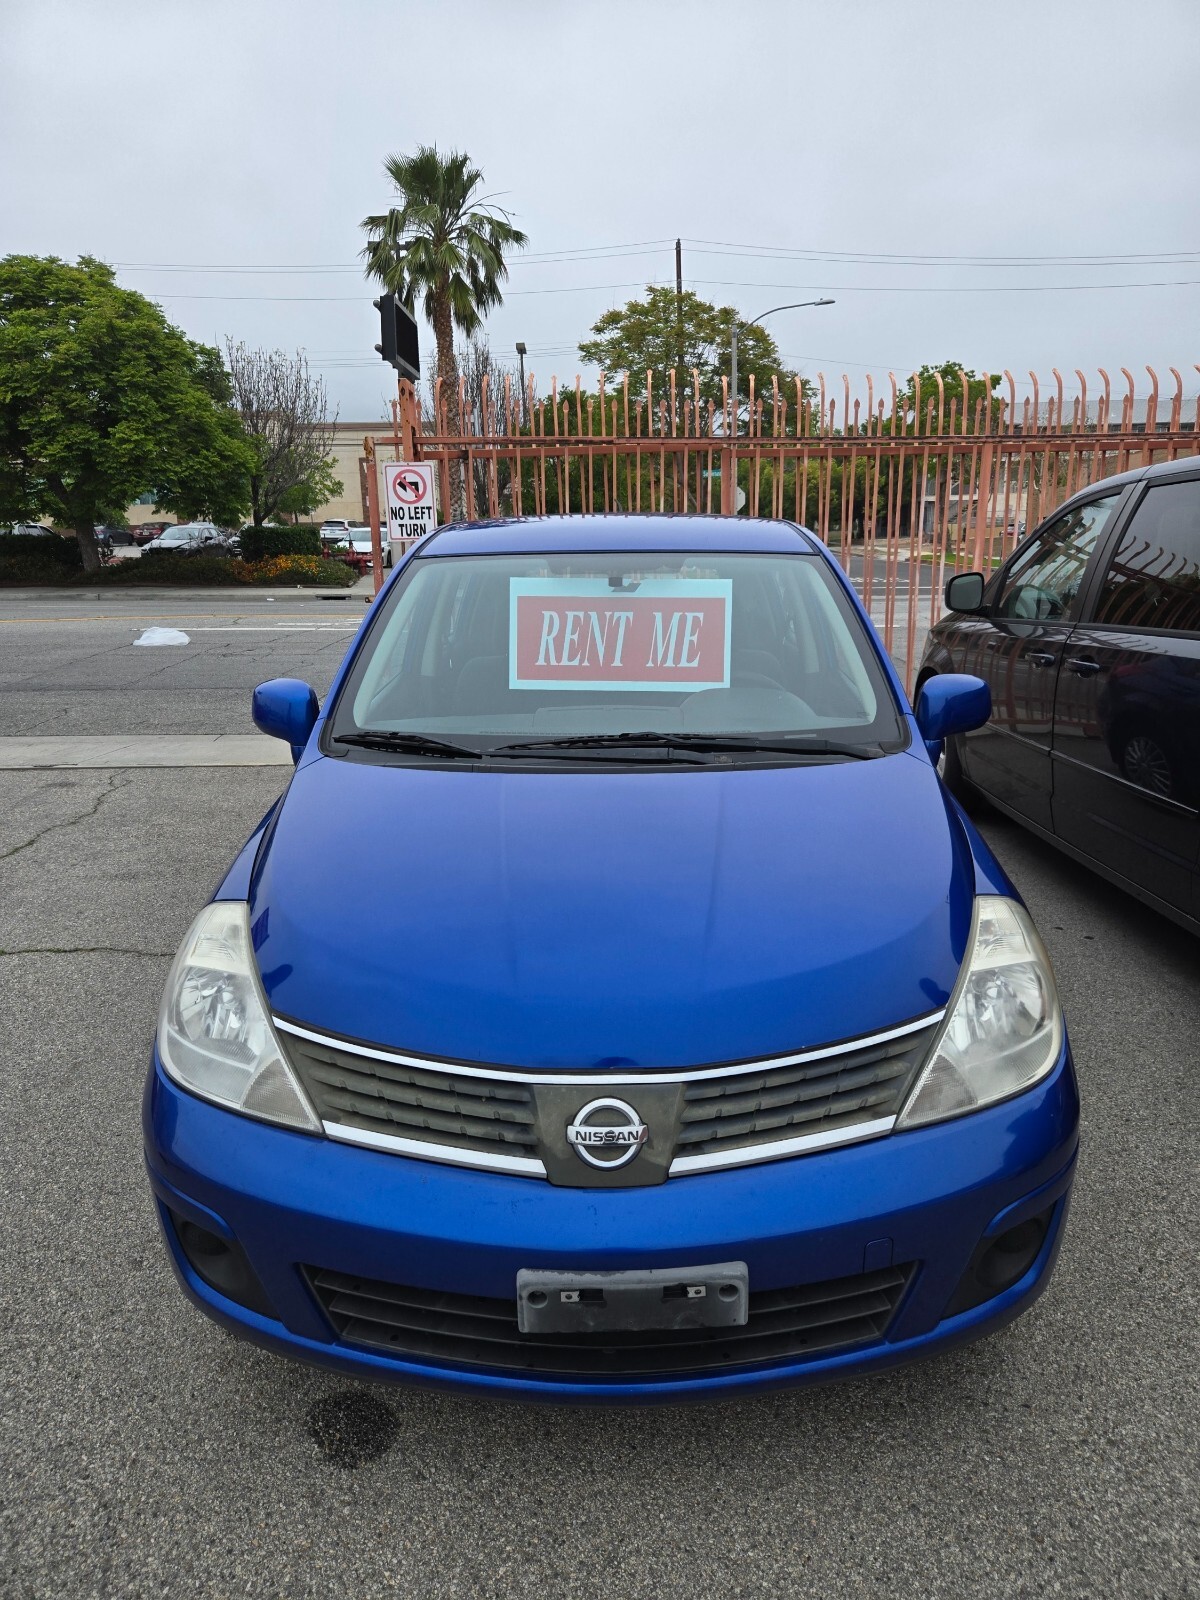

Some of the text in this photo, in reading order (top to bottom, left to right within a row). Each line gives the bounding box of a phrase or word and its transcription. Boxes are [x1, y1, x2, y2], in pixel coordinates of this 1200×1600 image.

[390, 506, 432, 520] NO LEFT
[398, 523, 427, 537] TURN
[535, 610, 704, 667] RENT ME
[575, 1130, 639, 1142] NISSAN
